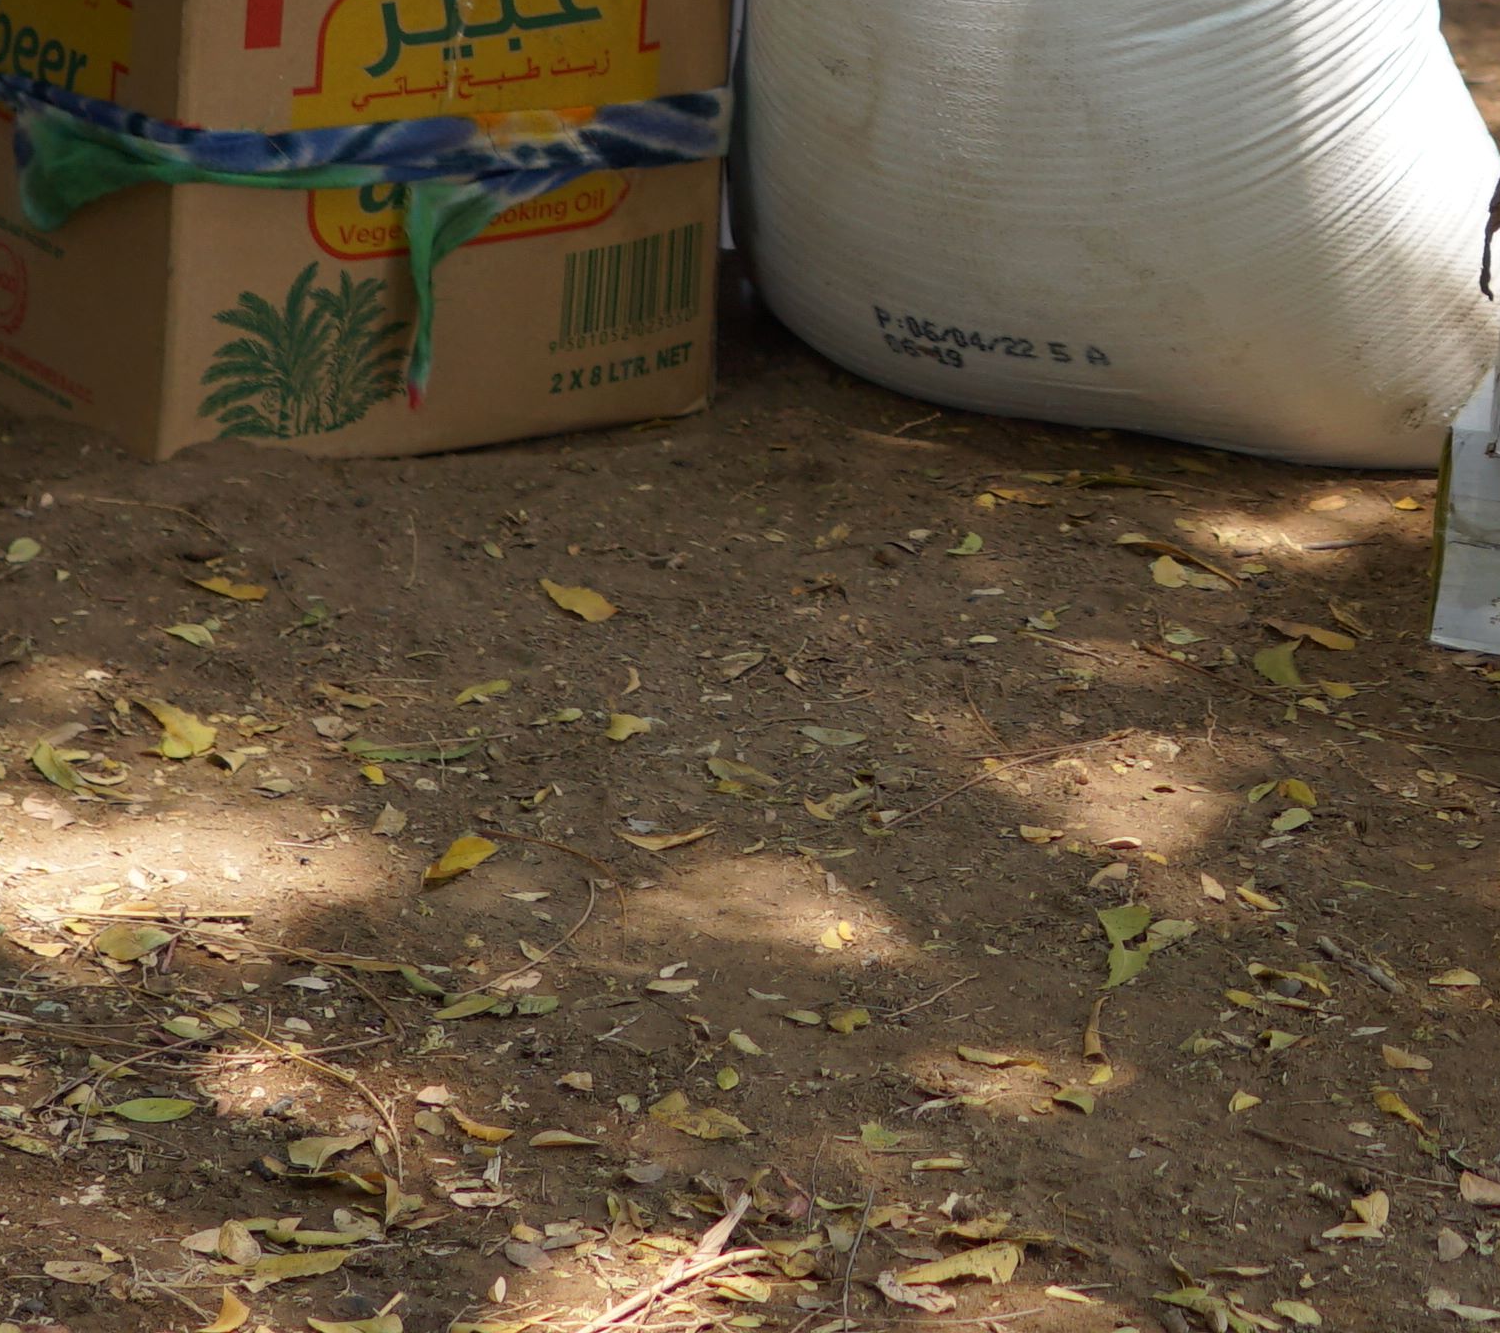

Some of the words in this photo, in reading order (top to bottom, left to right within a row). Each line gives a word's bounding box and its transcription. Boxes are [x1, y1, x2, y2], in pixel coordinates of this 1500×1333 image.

[457, 57, 541, 99] طبخ
[551, 49, 611, 78] زيت
[351, 70, 449, 113] نباتي
[489, 200, 569, 228] ooking
[573, 188, 606, 213] Oil
[550, 373, 564, 395] 2
[569, 368, 585, 391] X
[590, 364, 602, 387] 8
[608, 355, 650, 384] LTR.
[656, 340, 693, 372] NET
[1048, 340, 1073, 363] 5
[1085, 342, 1111, 367] A
